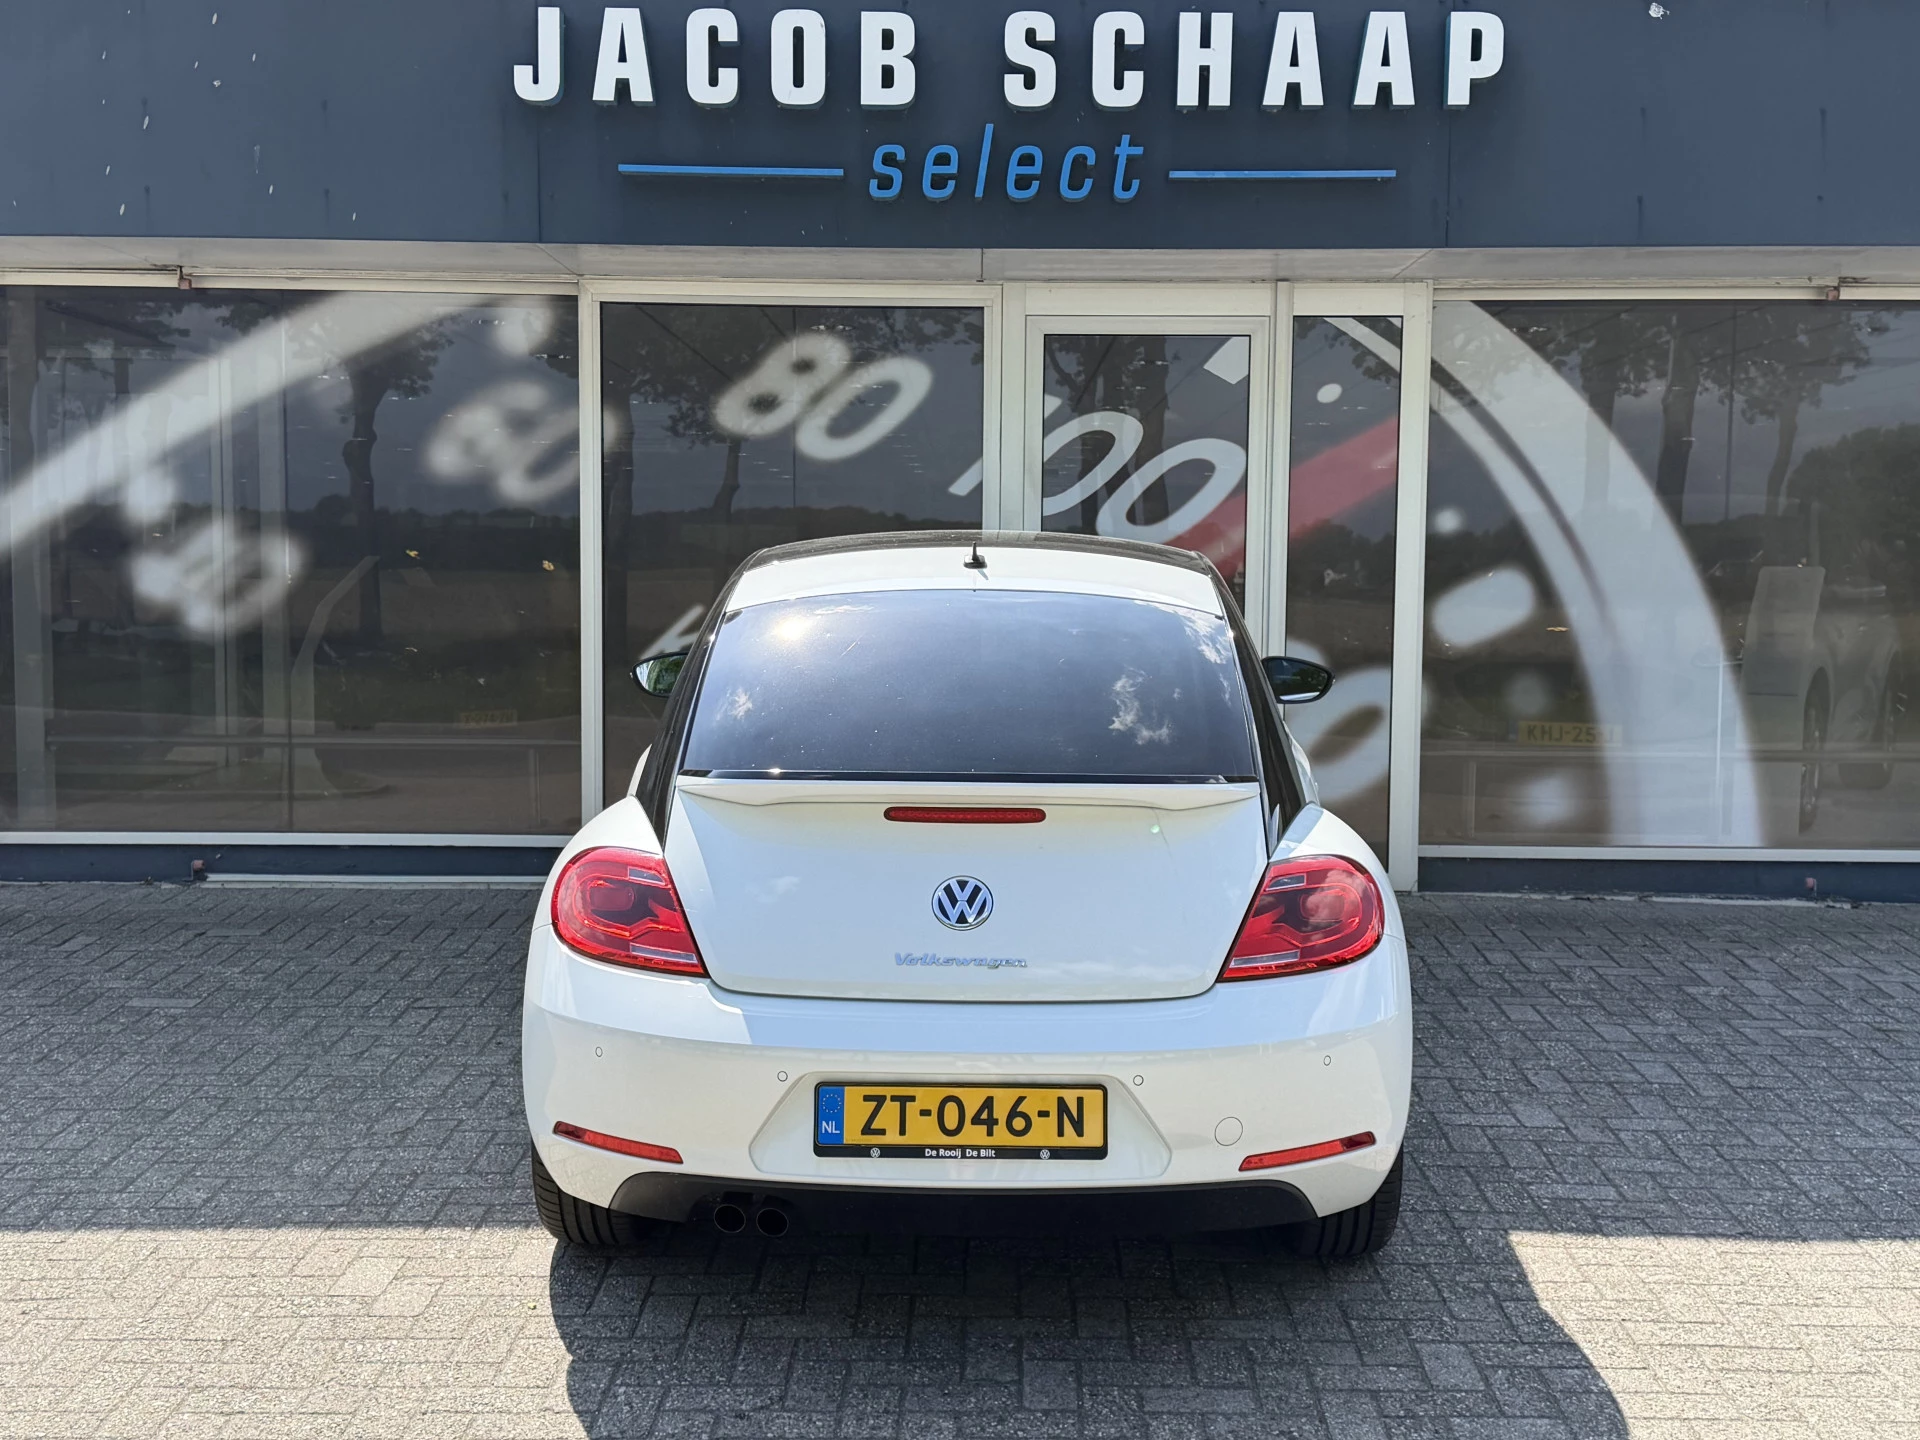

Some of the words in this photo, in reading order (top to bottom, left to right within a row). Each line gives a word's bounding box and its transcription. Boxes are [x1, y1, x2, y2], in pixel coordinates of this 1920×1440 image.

[513, 6, 917, 107] JACOB
[1003, 10, 1505, 108] SCHAAP
[868, 123, 1144, 201] select
[714, 333, 934, 461] 80
[895, 953, 1028, 970] Volkswagen
[821, 1120, 841, 1134] NL
[860, 1094, 1085, 1138] ZT-046-N
[925, 1148, 937, 1157] De
[939, 1148, 961, 1159] Rooij
[966, 1149, 978, 1158] De
[980, 1149, 996, 1158] Bilt
